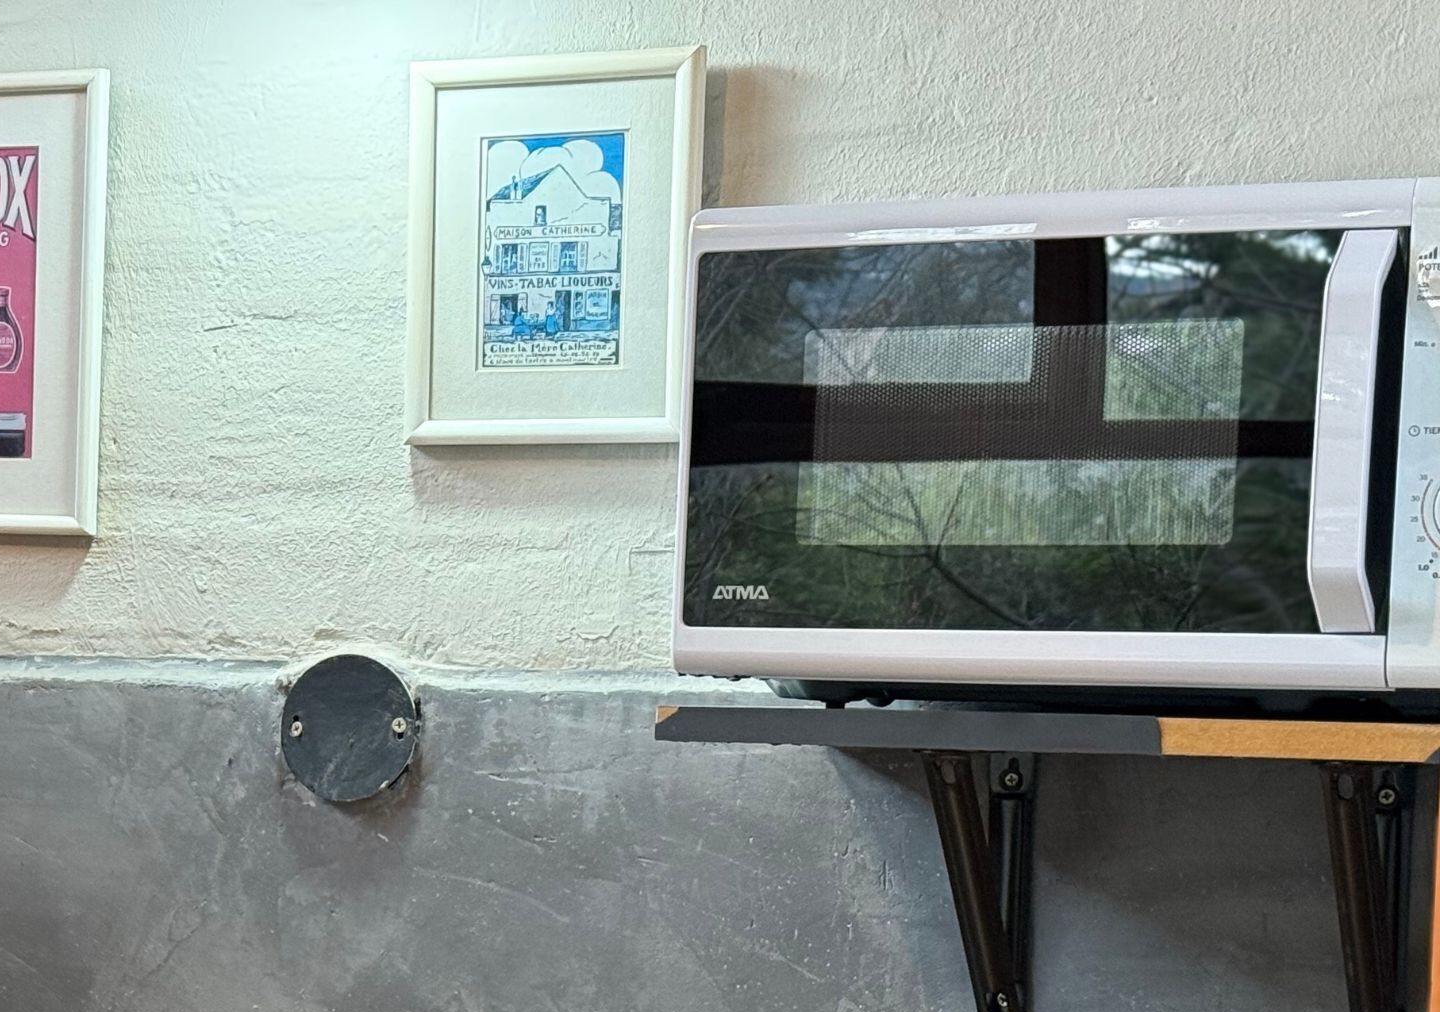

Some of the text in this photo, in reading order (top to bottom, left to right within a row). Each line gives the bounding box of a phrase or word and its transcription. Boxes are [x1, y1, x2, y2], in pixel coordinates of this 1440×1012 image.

[498, 226, 597, 238] MAISON CATHERINE
[712, 585, 769, 600] ATMA
